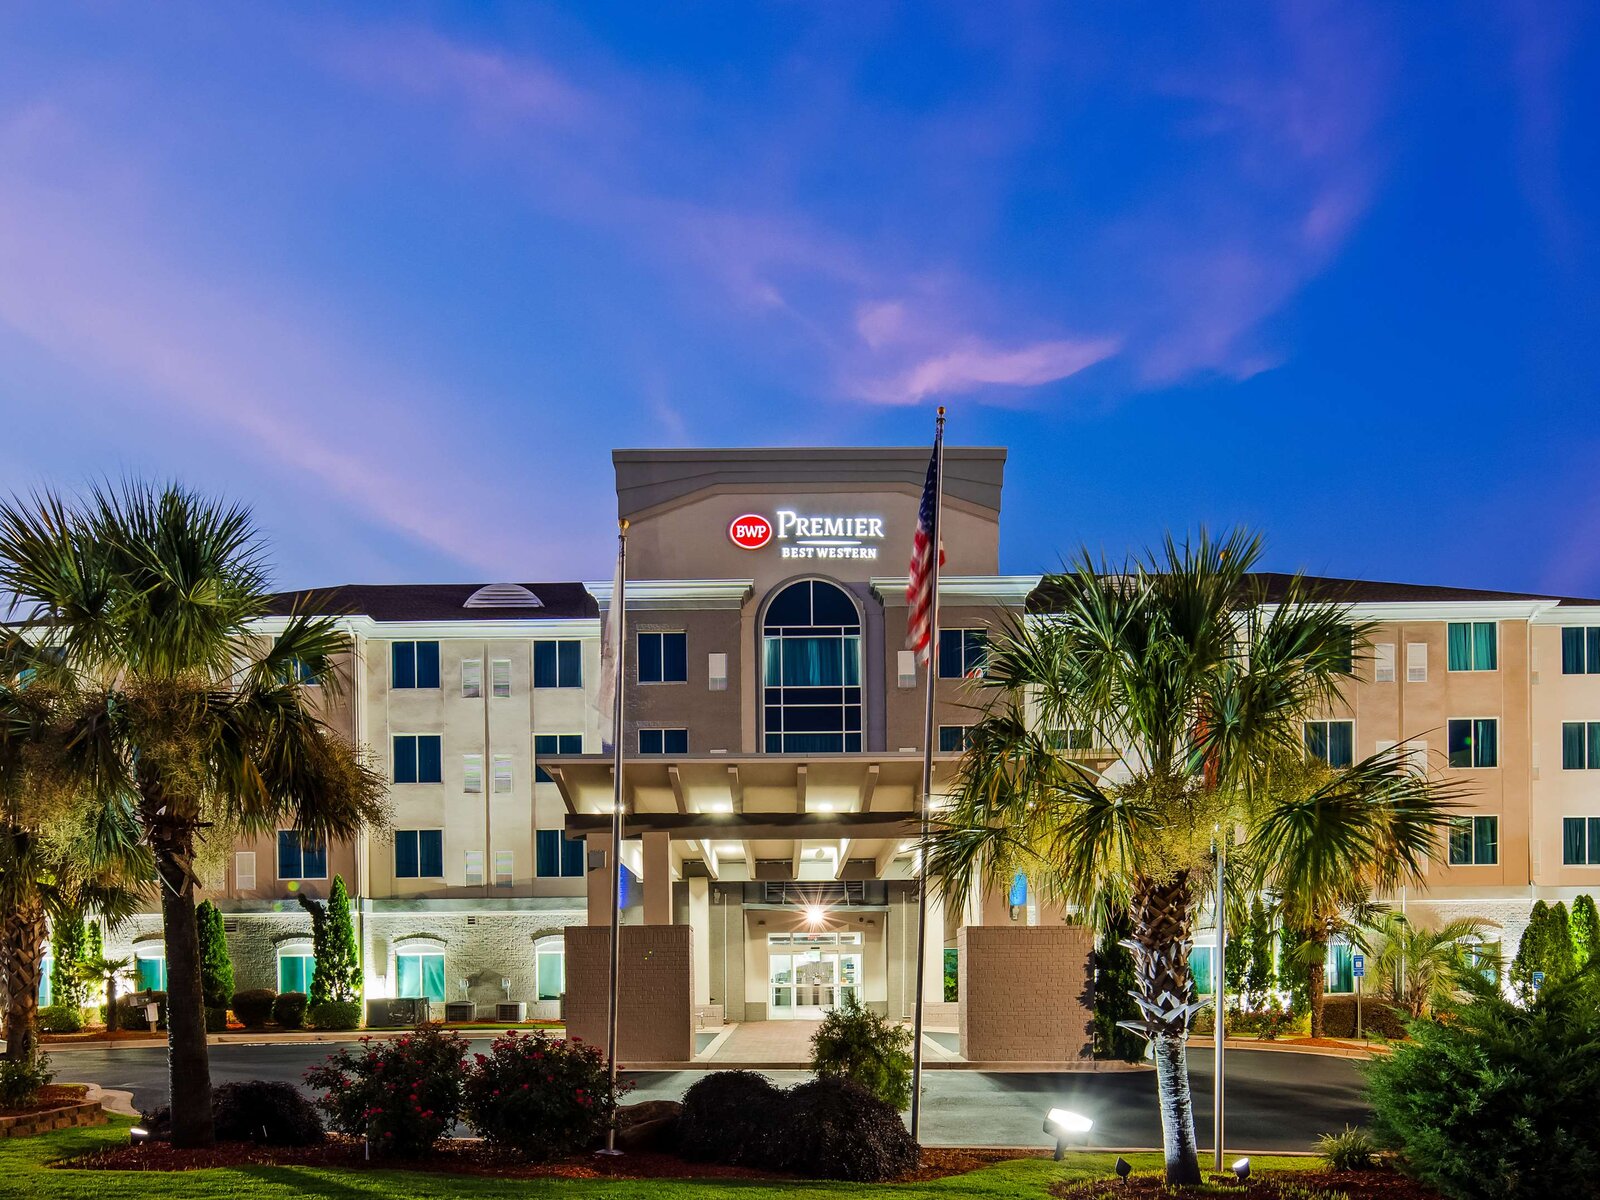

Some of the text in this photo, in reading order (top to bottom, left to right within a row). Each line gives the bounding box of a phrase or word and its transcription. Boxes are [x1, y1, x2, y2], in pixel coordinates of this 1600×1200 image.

[776, 511, 884, 537] PREMIER
[736, 525, 766, 538] BWP
[782, 547, 877, 558] BEST WESTERN
